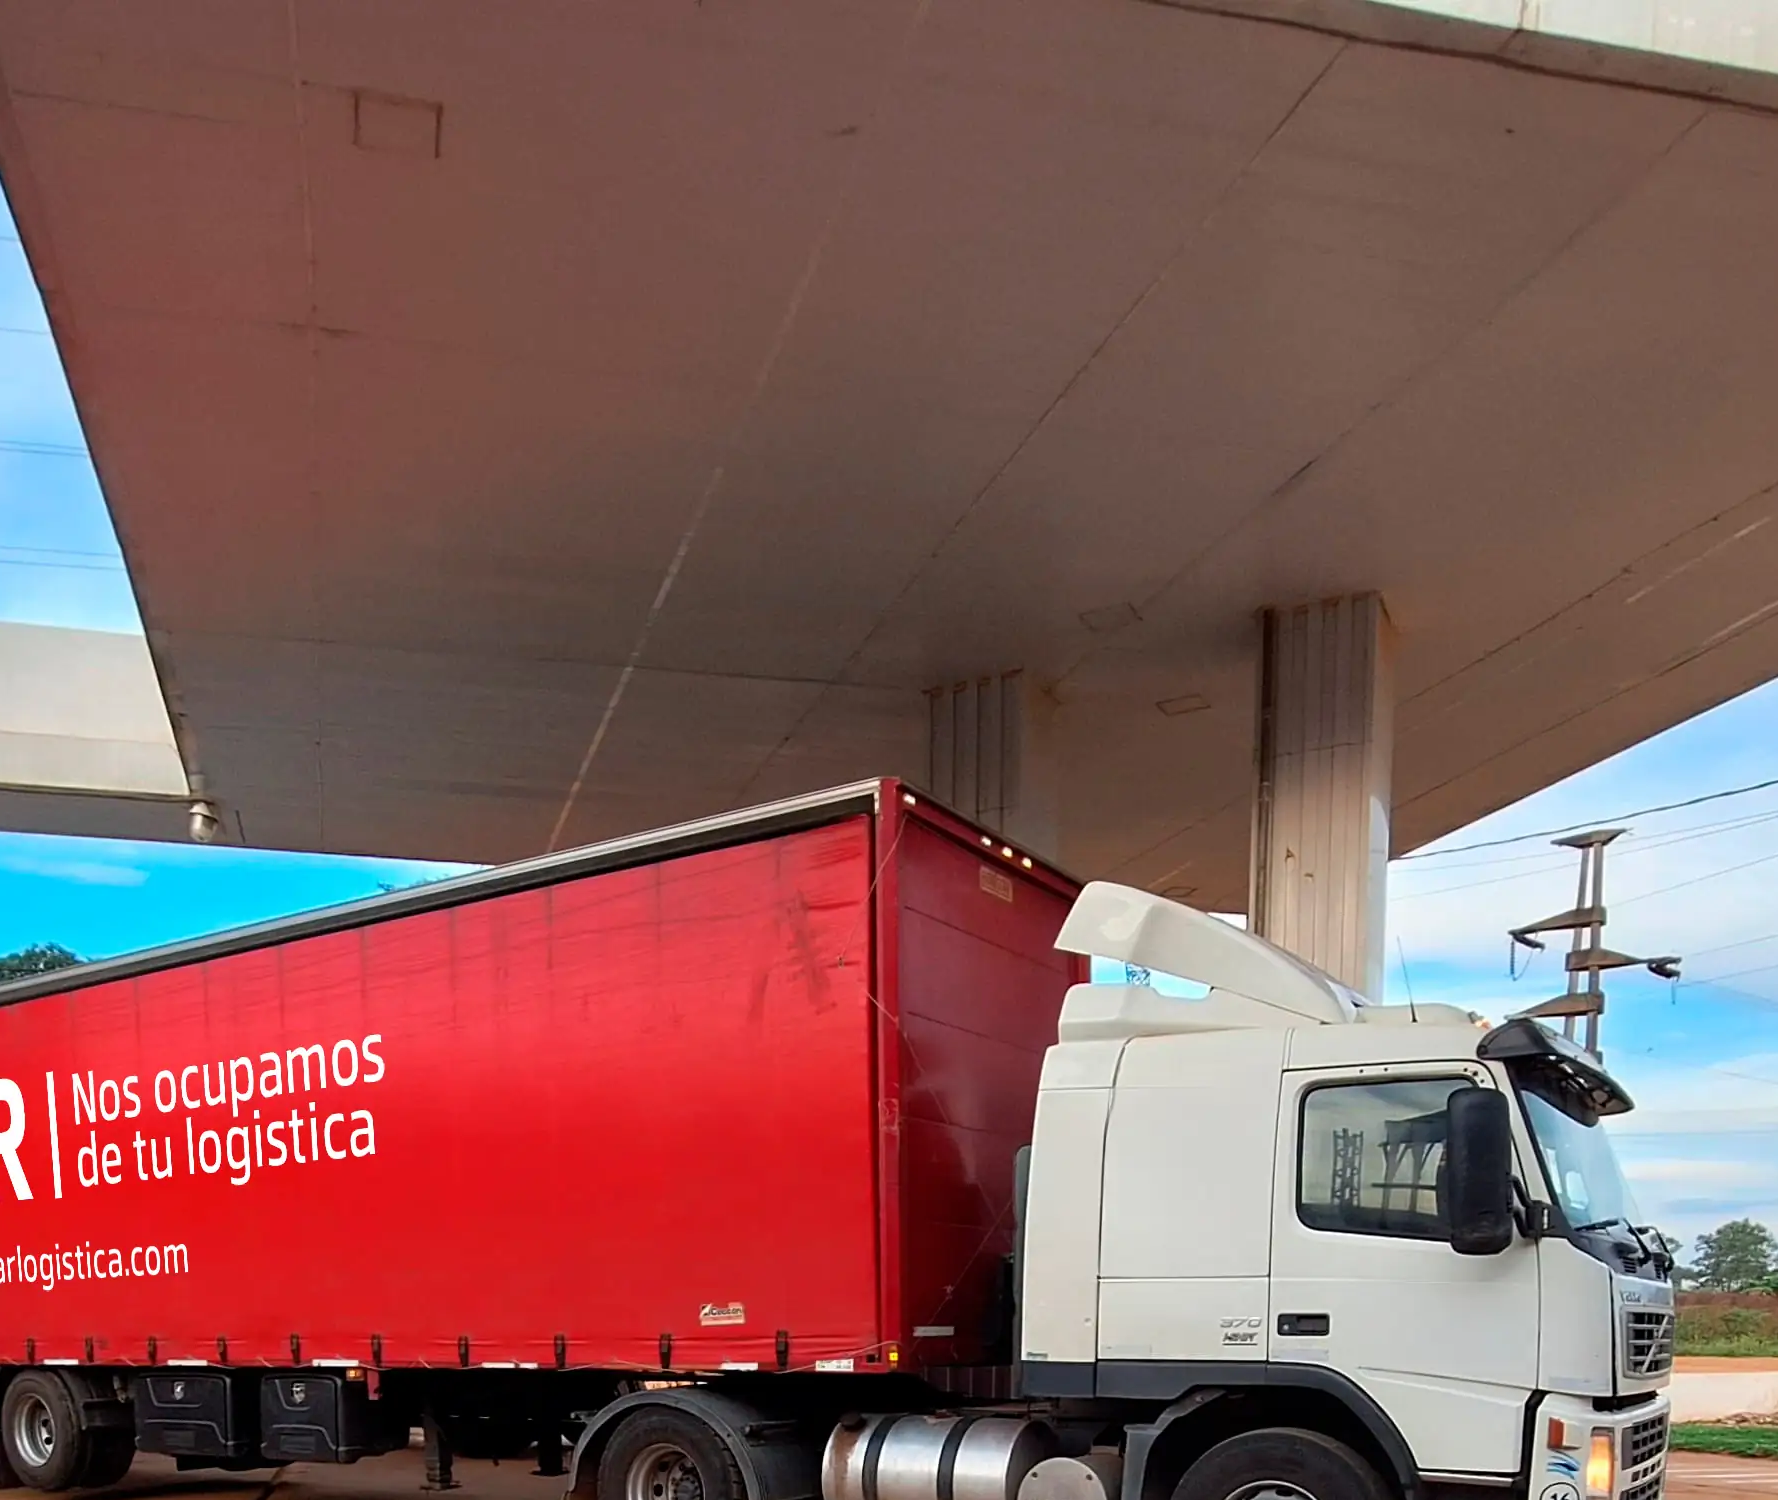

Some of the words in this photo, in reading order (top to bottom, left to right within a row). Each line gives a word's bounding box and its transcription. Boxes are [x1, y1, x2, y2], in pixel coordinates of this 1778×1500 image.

[71, 1070, 142, 1126] Nos
[154, 1033, 386, 1118] ocupamos
[76, 1130, 122, 1188] de
[132, 1130, 173, 1181] tu
[185, 1101, 377, 1187] logistica
